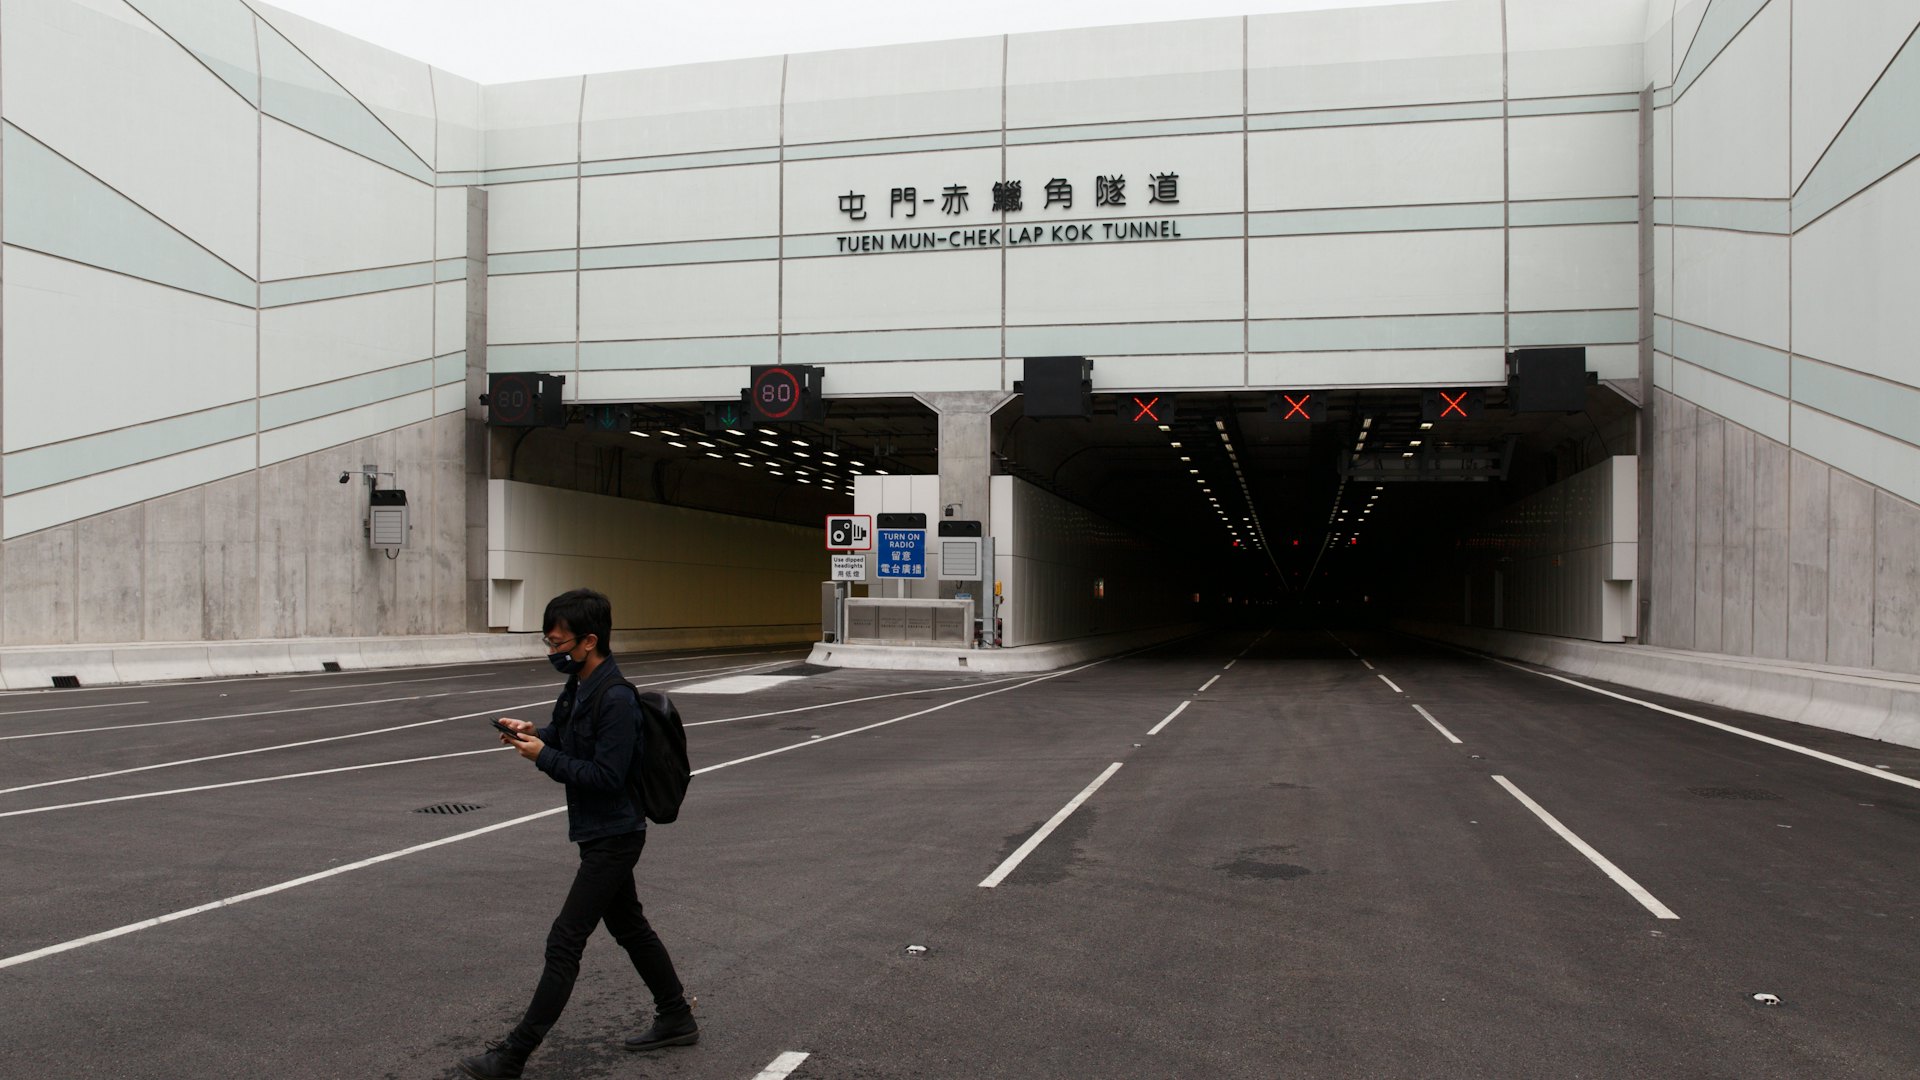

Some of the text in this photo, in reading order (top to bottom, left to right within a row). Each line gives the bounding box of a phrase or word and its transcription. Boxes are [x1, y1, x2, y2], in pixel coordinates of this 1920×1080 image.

[837, 220, 1181, 252] TUEN MUN-CHEK LAP KOK TUNNEL
[499, 391, 523, 407] 80
[762, 384, 790, 402] 80
[891, 550, 912, 561] 留意
[880, 563, 922, 575] 電台廣播
